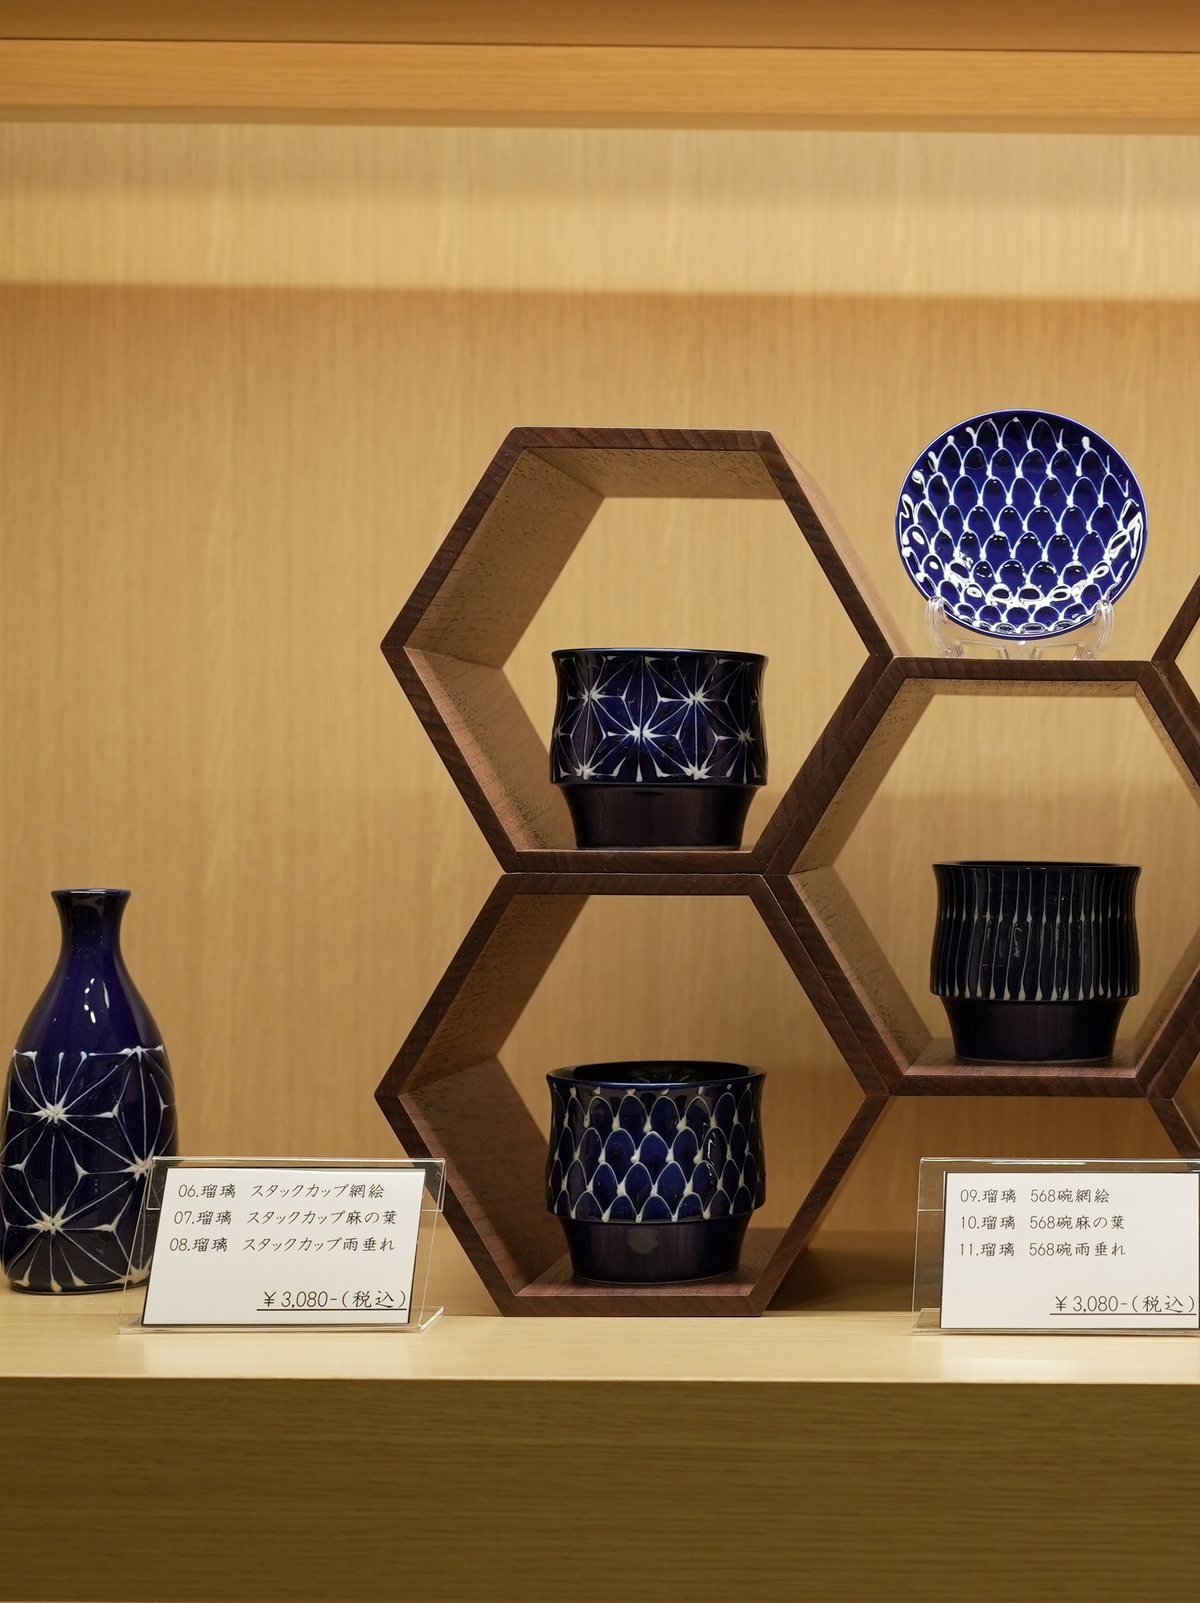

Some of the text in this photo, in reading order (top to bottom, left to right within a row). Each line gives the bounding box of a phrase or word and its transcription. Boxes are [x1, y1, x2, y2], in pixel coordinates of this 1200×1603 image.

[178, 1184, 384, 1199] 06.瑠璃 スタックカップ網絵
[960, 1188, 1110, 1203] 09.瑠璃 568碗網絵
[174, 1210, 397, 1225] 07.瑠璃 スタックカップ麻の葉
[960, 1215, 1125, 1230] 10.瑠璃 568碗麻の葉
[169, 1237, 396, 1252] 08.瑠璃 スタックカップ雨垂れ
[960, 1242, 1126, 1257] 11.瑠璃 568碗雨垂れ
